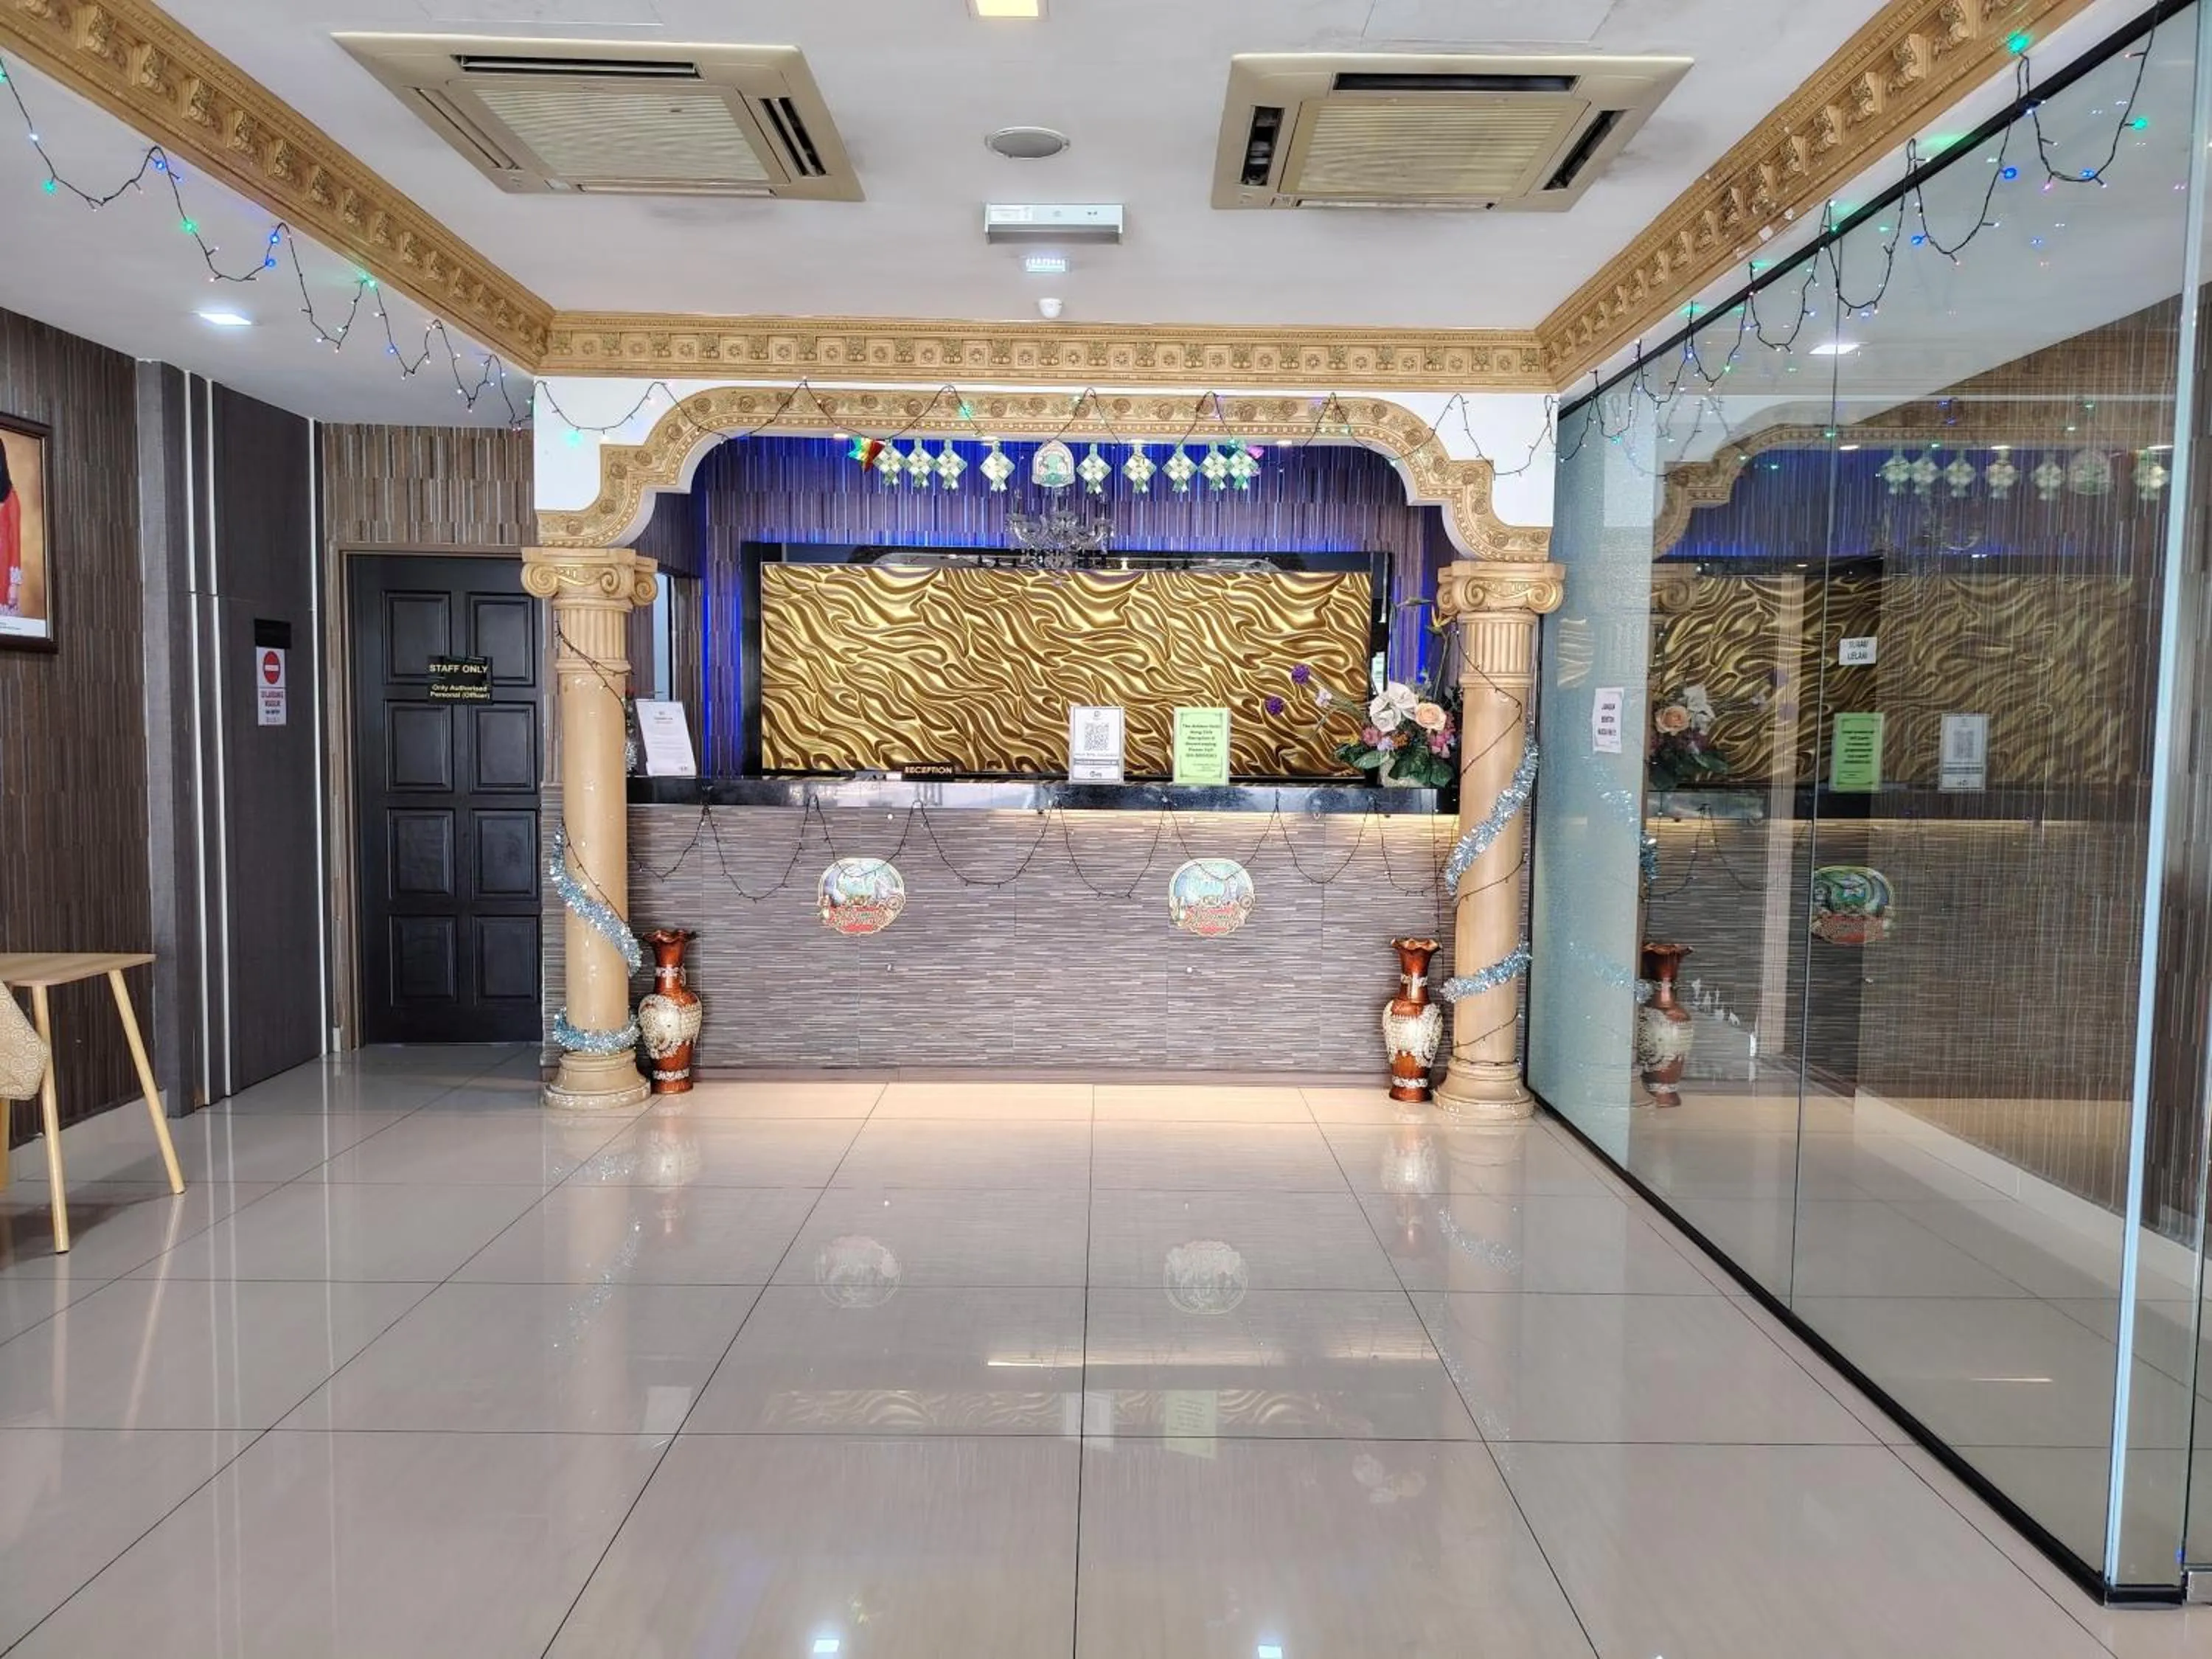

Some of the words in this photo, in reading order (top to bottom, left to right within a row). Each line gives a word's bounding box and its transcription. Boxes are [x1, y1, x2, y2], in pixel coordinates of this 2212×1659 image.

[429, 664, 460, 673] STAFF
[462, 664, 488, 673] ONLY
[431, 684, 449, 692] Only
[904, 766, 953, 774] RECEPTION
